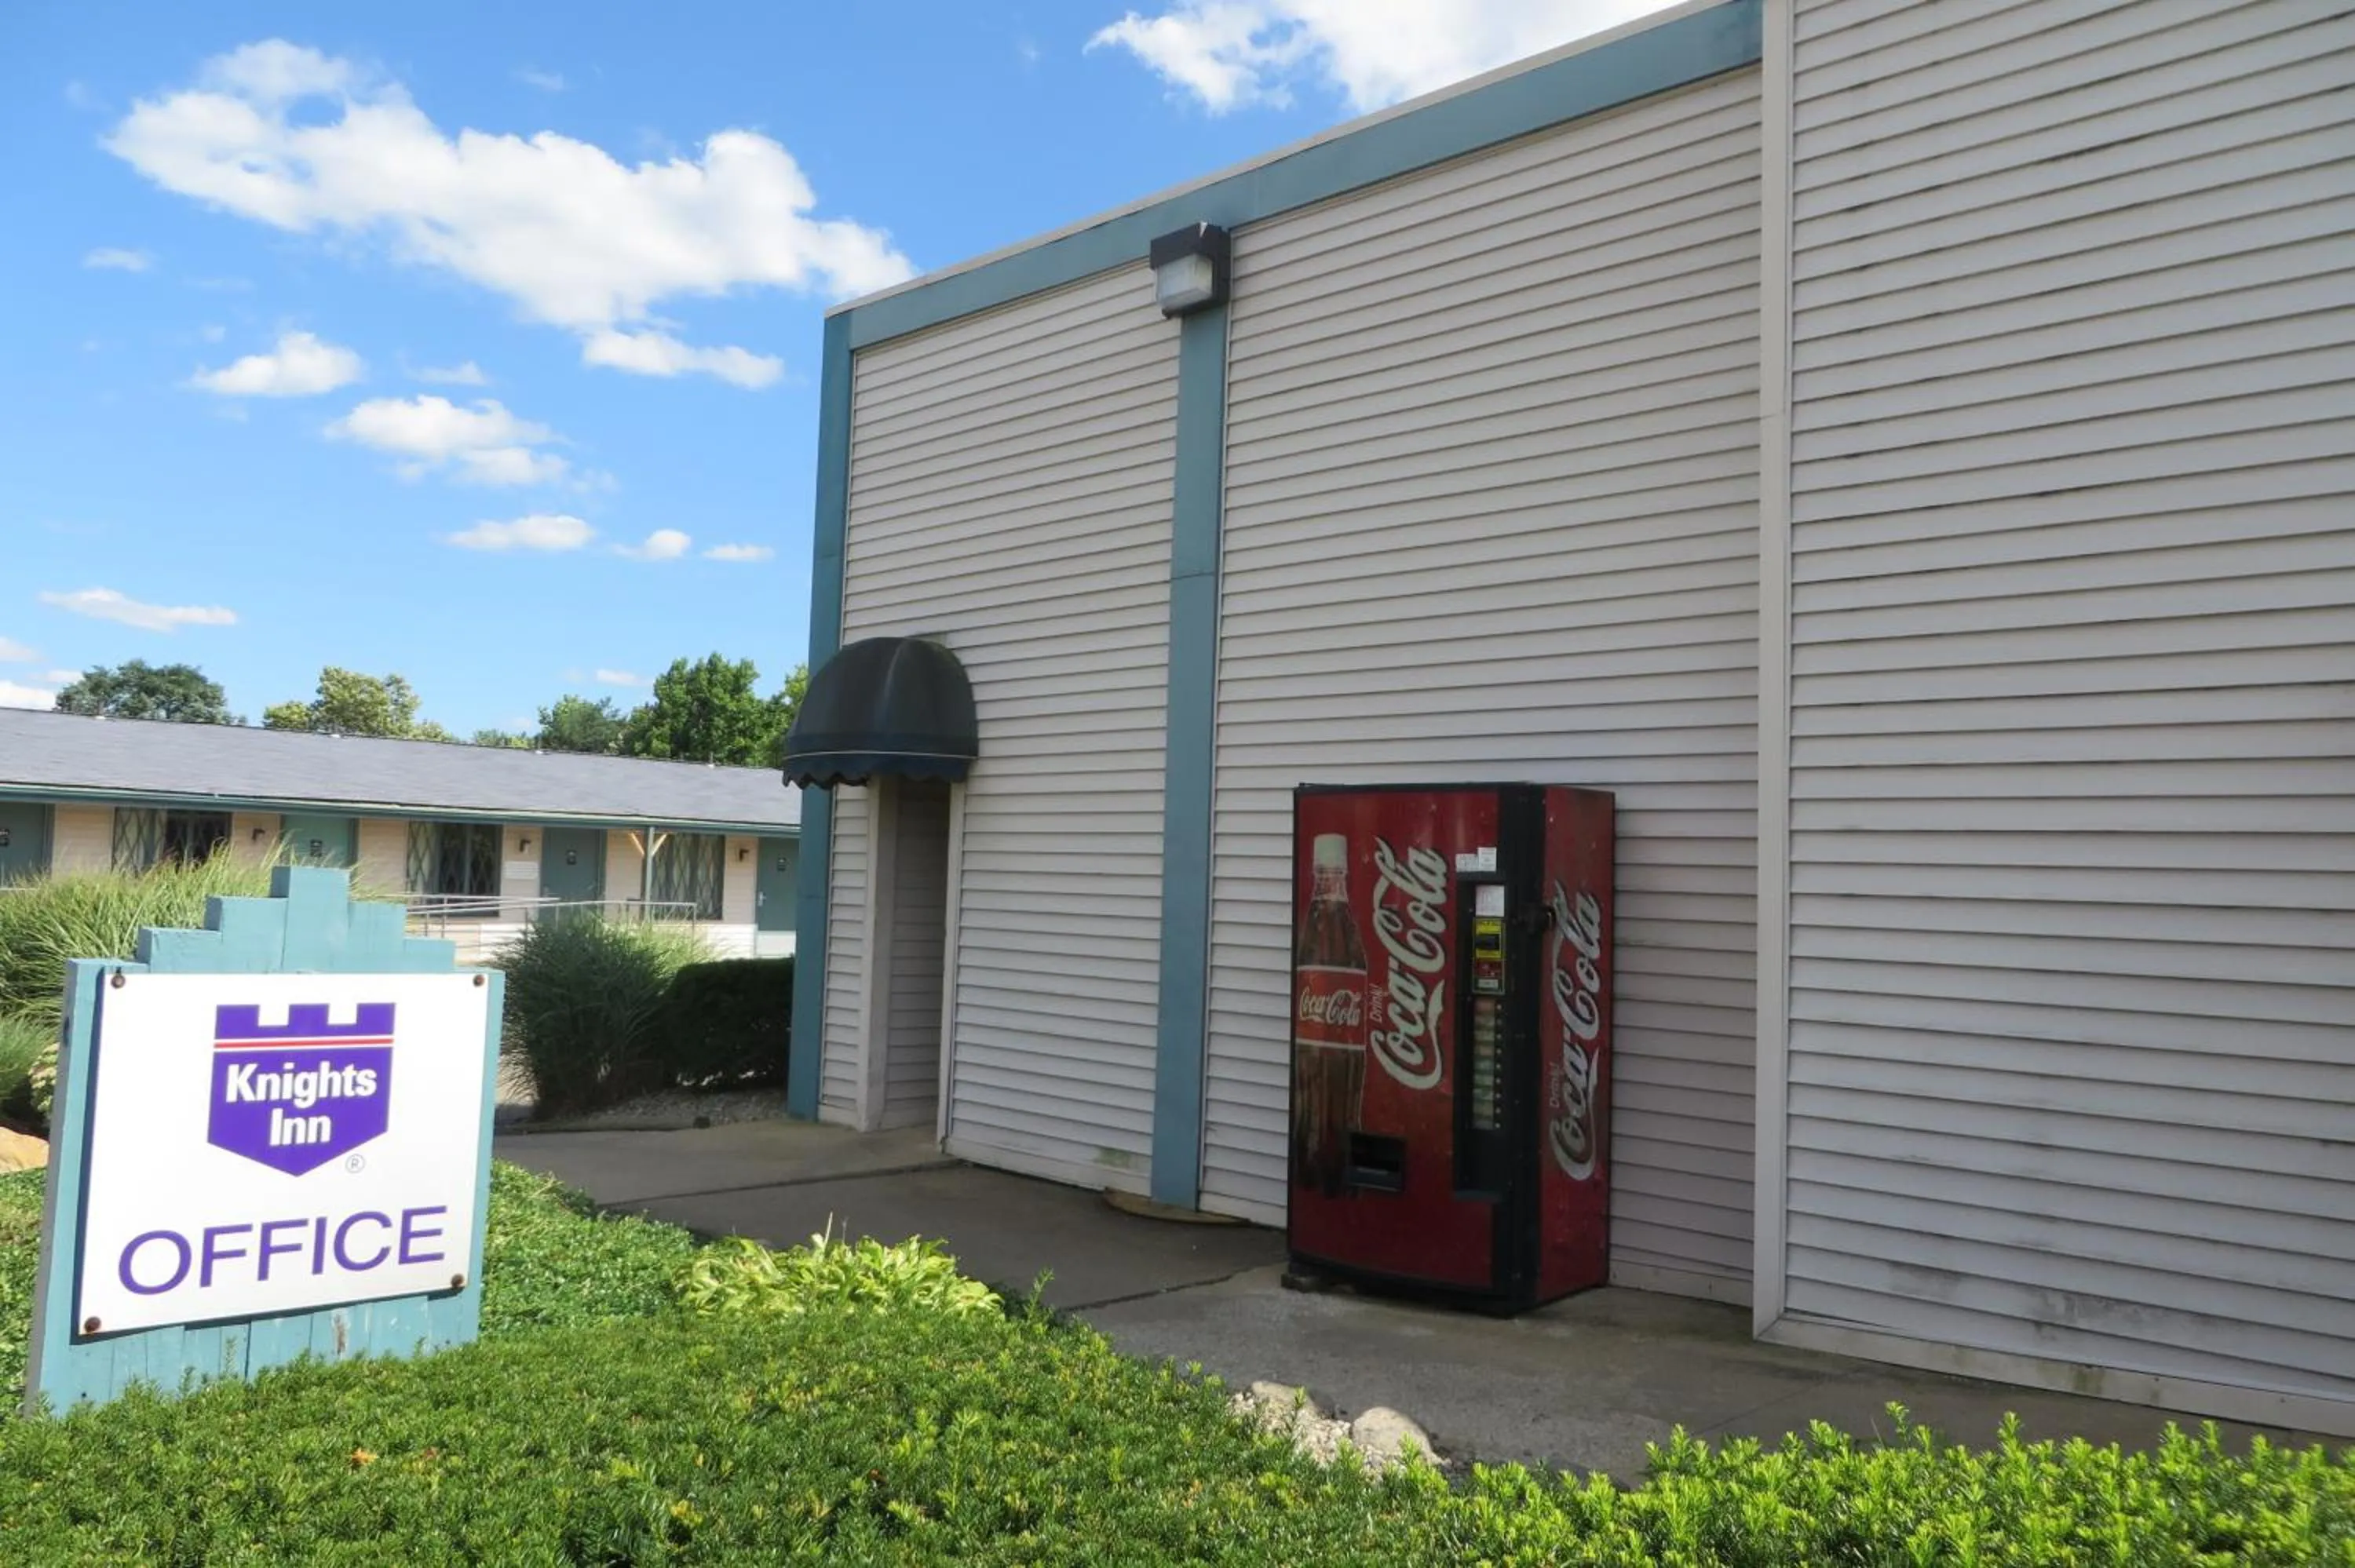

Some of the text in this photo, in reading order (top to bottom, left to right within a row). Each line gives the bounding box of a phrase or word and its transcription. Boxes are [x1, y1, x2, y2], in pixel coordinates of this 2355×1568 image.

[225, 1060, 378, 1109] Knights
[269, 1107, 331, 1147] Inn
[118, 1205, 447, 1295] OFFICE
